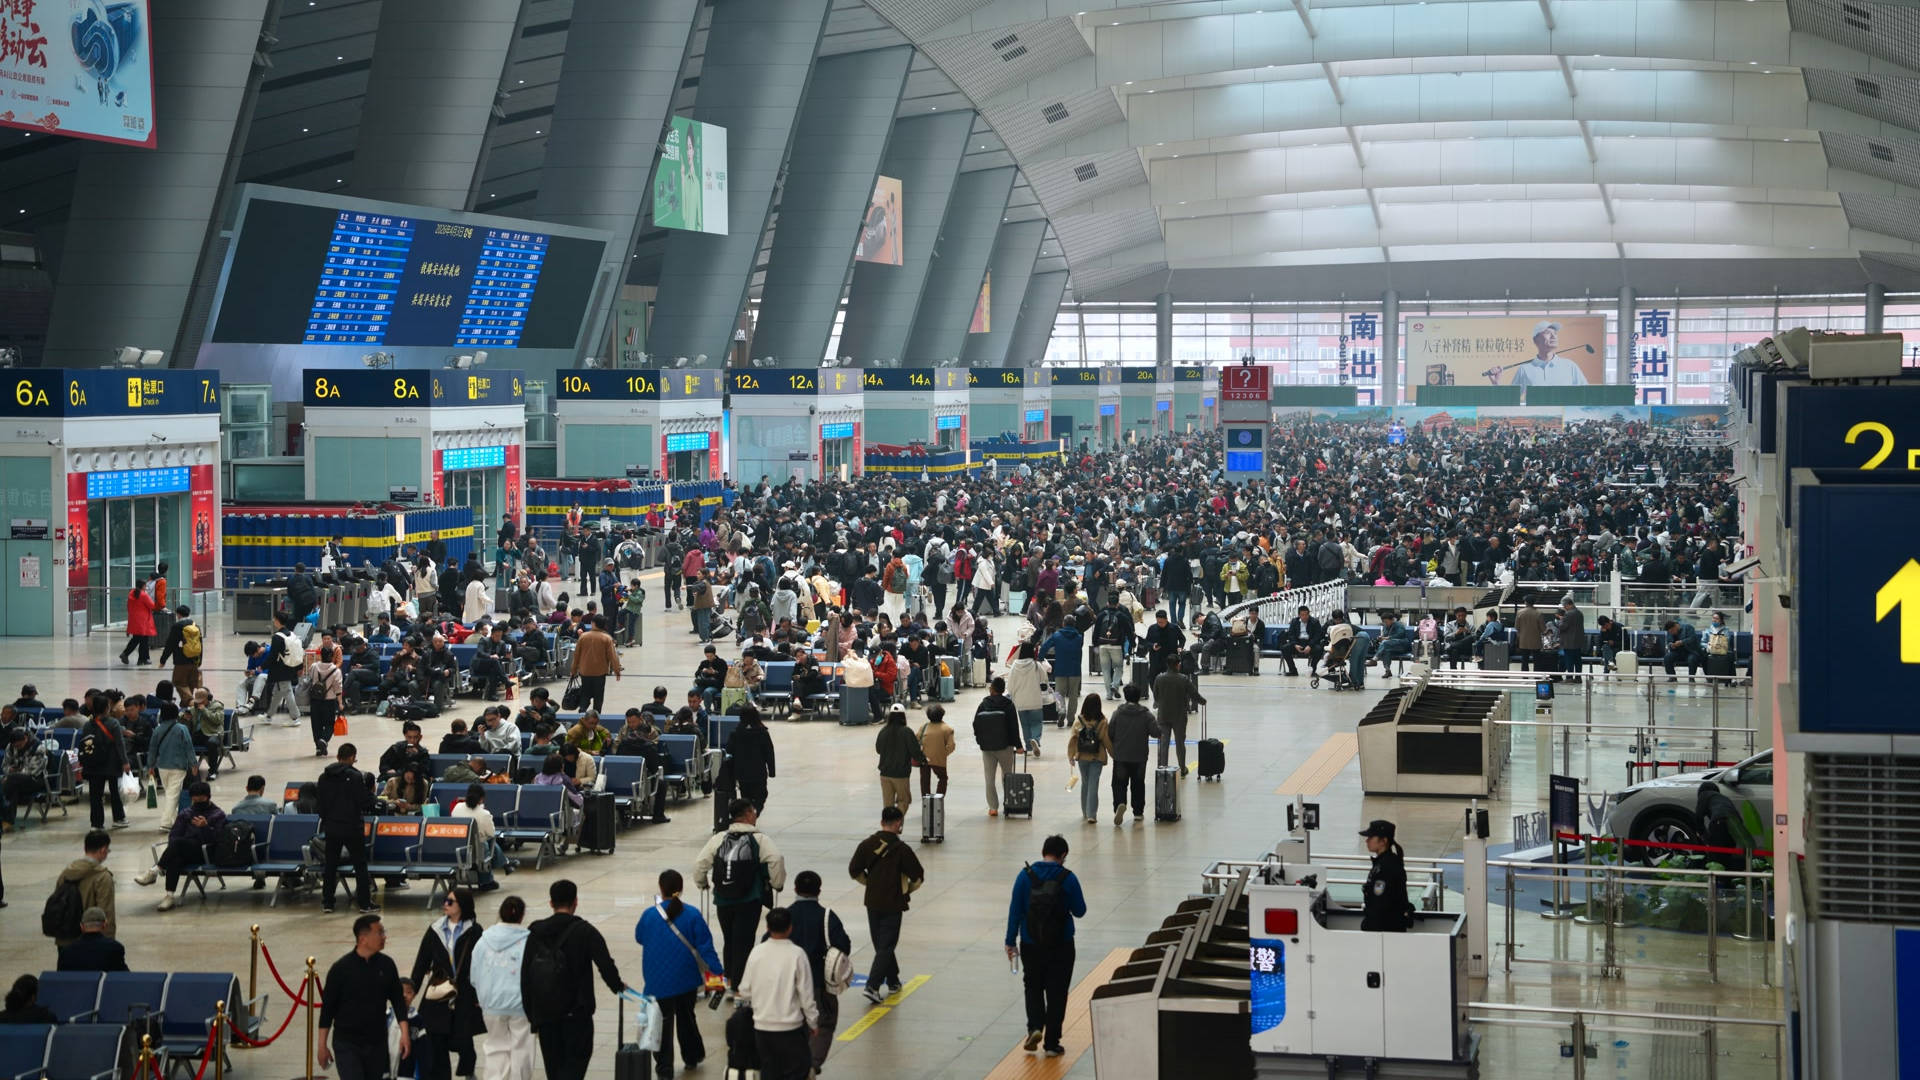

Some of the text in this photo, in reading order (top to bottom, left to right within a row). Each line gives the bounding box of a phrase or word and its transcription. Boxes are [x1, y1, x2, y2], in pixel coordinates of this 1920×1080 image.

[1339, 335, 1348, 371] South
[1423, 338, 1471, 353] 八子补肾精
[1629, 332, 1639, 368] South
[735, 375, 759, 389] 12A
[789, 375, 814, 389] 12A
[863, 374, 884, 386] 14A
[909, 373, 931, 386] 14A
[1001, 373, 1020, 384] 16A
[1079, 372, 1096, 381] 18A
[1137, 371, 1153, 380] 20A
[1186, 370, 1201, 378] 22A
[16, 379, 49, 406] 6A
[143, 379, 164, 395] 检票口
[201, 380, 217, 403] 7A
[315, 378, 340, 398] 8A
[393, 378, 419, 399] 8A
[433, 379, 444, 398] 8A
[513, 378, 523, 397] 9A
[562, 376, 591, 393] 10A
[626, 376, 655, 393] 10A
[661, 377, 671, 393] 10A
[70, 380, 87, 407] 6A
[143, 397, 154, 406] Check
[391, 825, 417, 833] 爱心专座
[439, 827, 465, 835] 爱心专座
